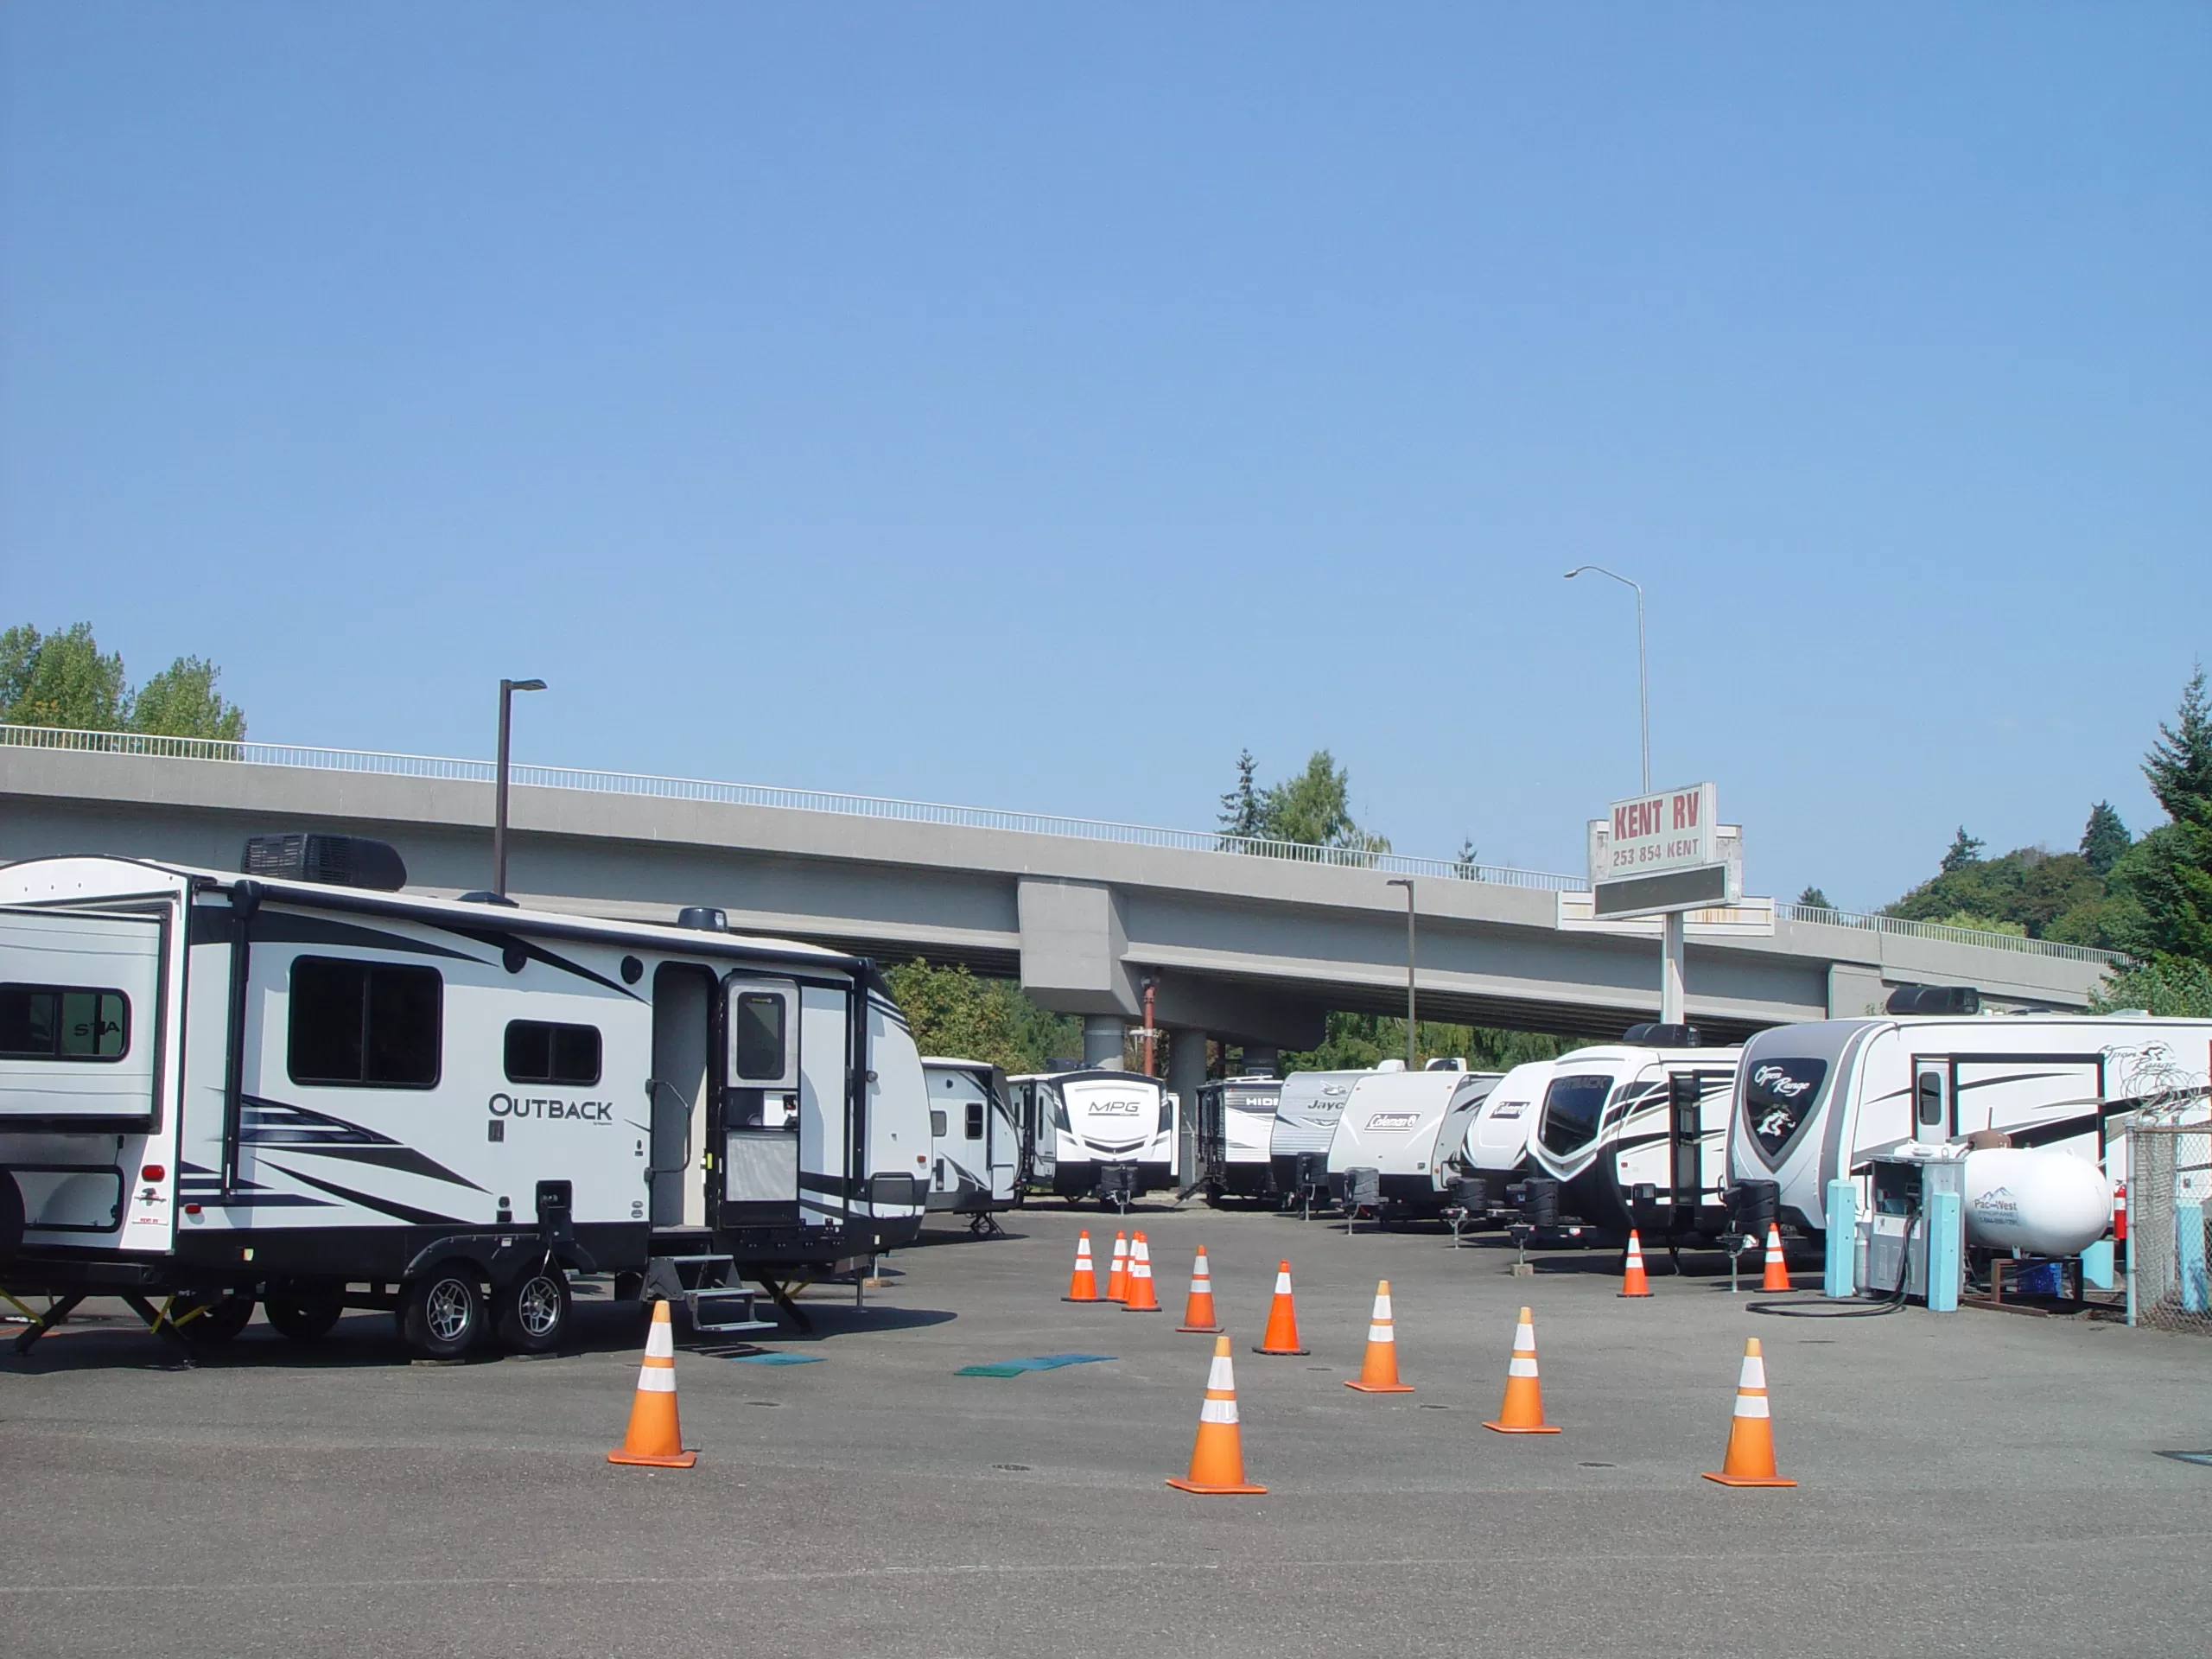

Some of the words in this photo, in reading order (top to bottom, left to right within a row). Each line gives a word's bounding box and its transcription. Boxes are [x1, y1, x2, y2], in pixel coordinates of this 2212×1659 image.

[1614, 798, 1663, 841] KENT
[1673, 791, 1699, 830] RV
[1613, 849, 1635, 867] 253
[1639, 845, 1662, 862] 854
[1667, 839, 1699, 858] KENT
[1754, 1065, 1783, 1086] Open
[1771, 1077, 1810, 1096] Range
[488, 1093, 613, 1121] OUTBACK
[1089, 1102, 1141, 1112] MPG
